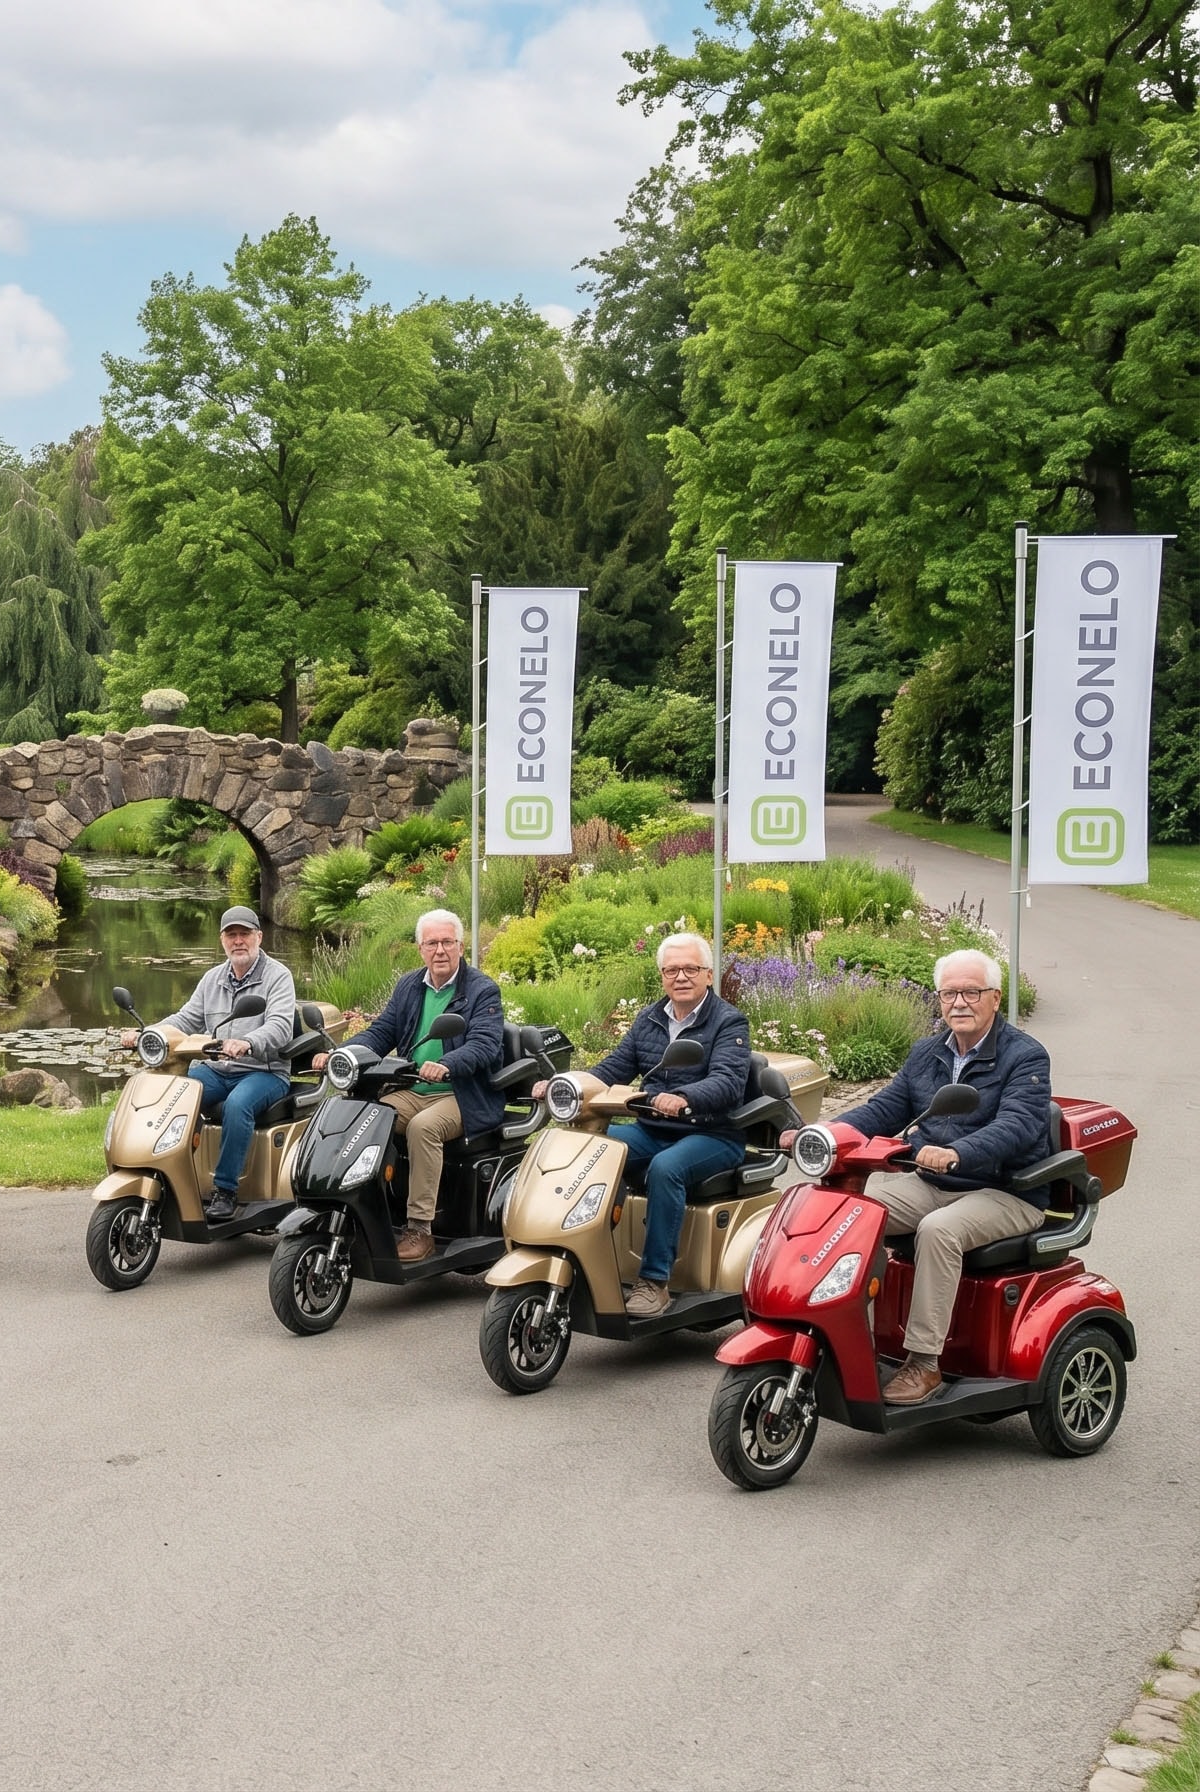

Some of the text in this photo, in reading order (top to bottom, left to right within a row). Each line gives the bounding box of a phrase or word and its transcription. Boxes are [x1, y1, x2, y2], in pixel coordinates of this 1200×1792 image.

[517, 605, 550, 784] ECONELO
[764, 581, 802, 781] ECONELO
[1073, 558, 1121, 791] ECONELO
